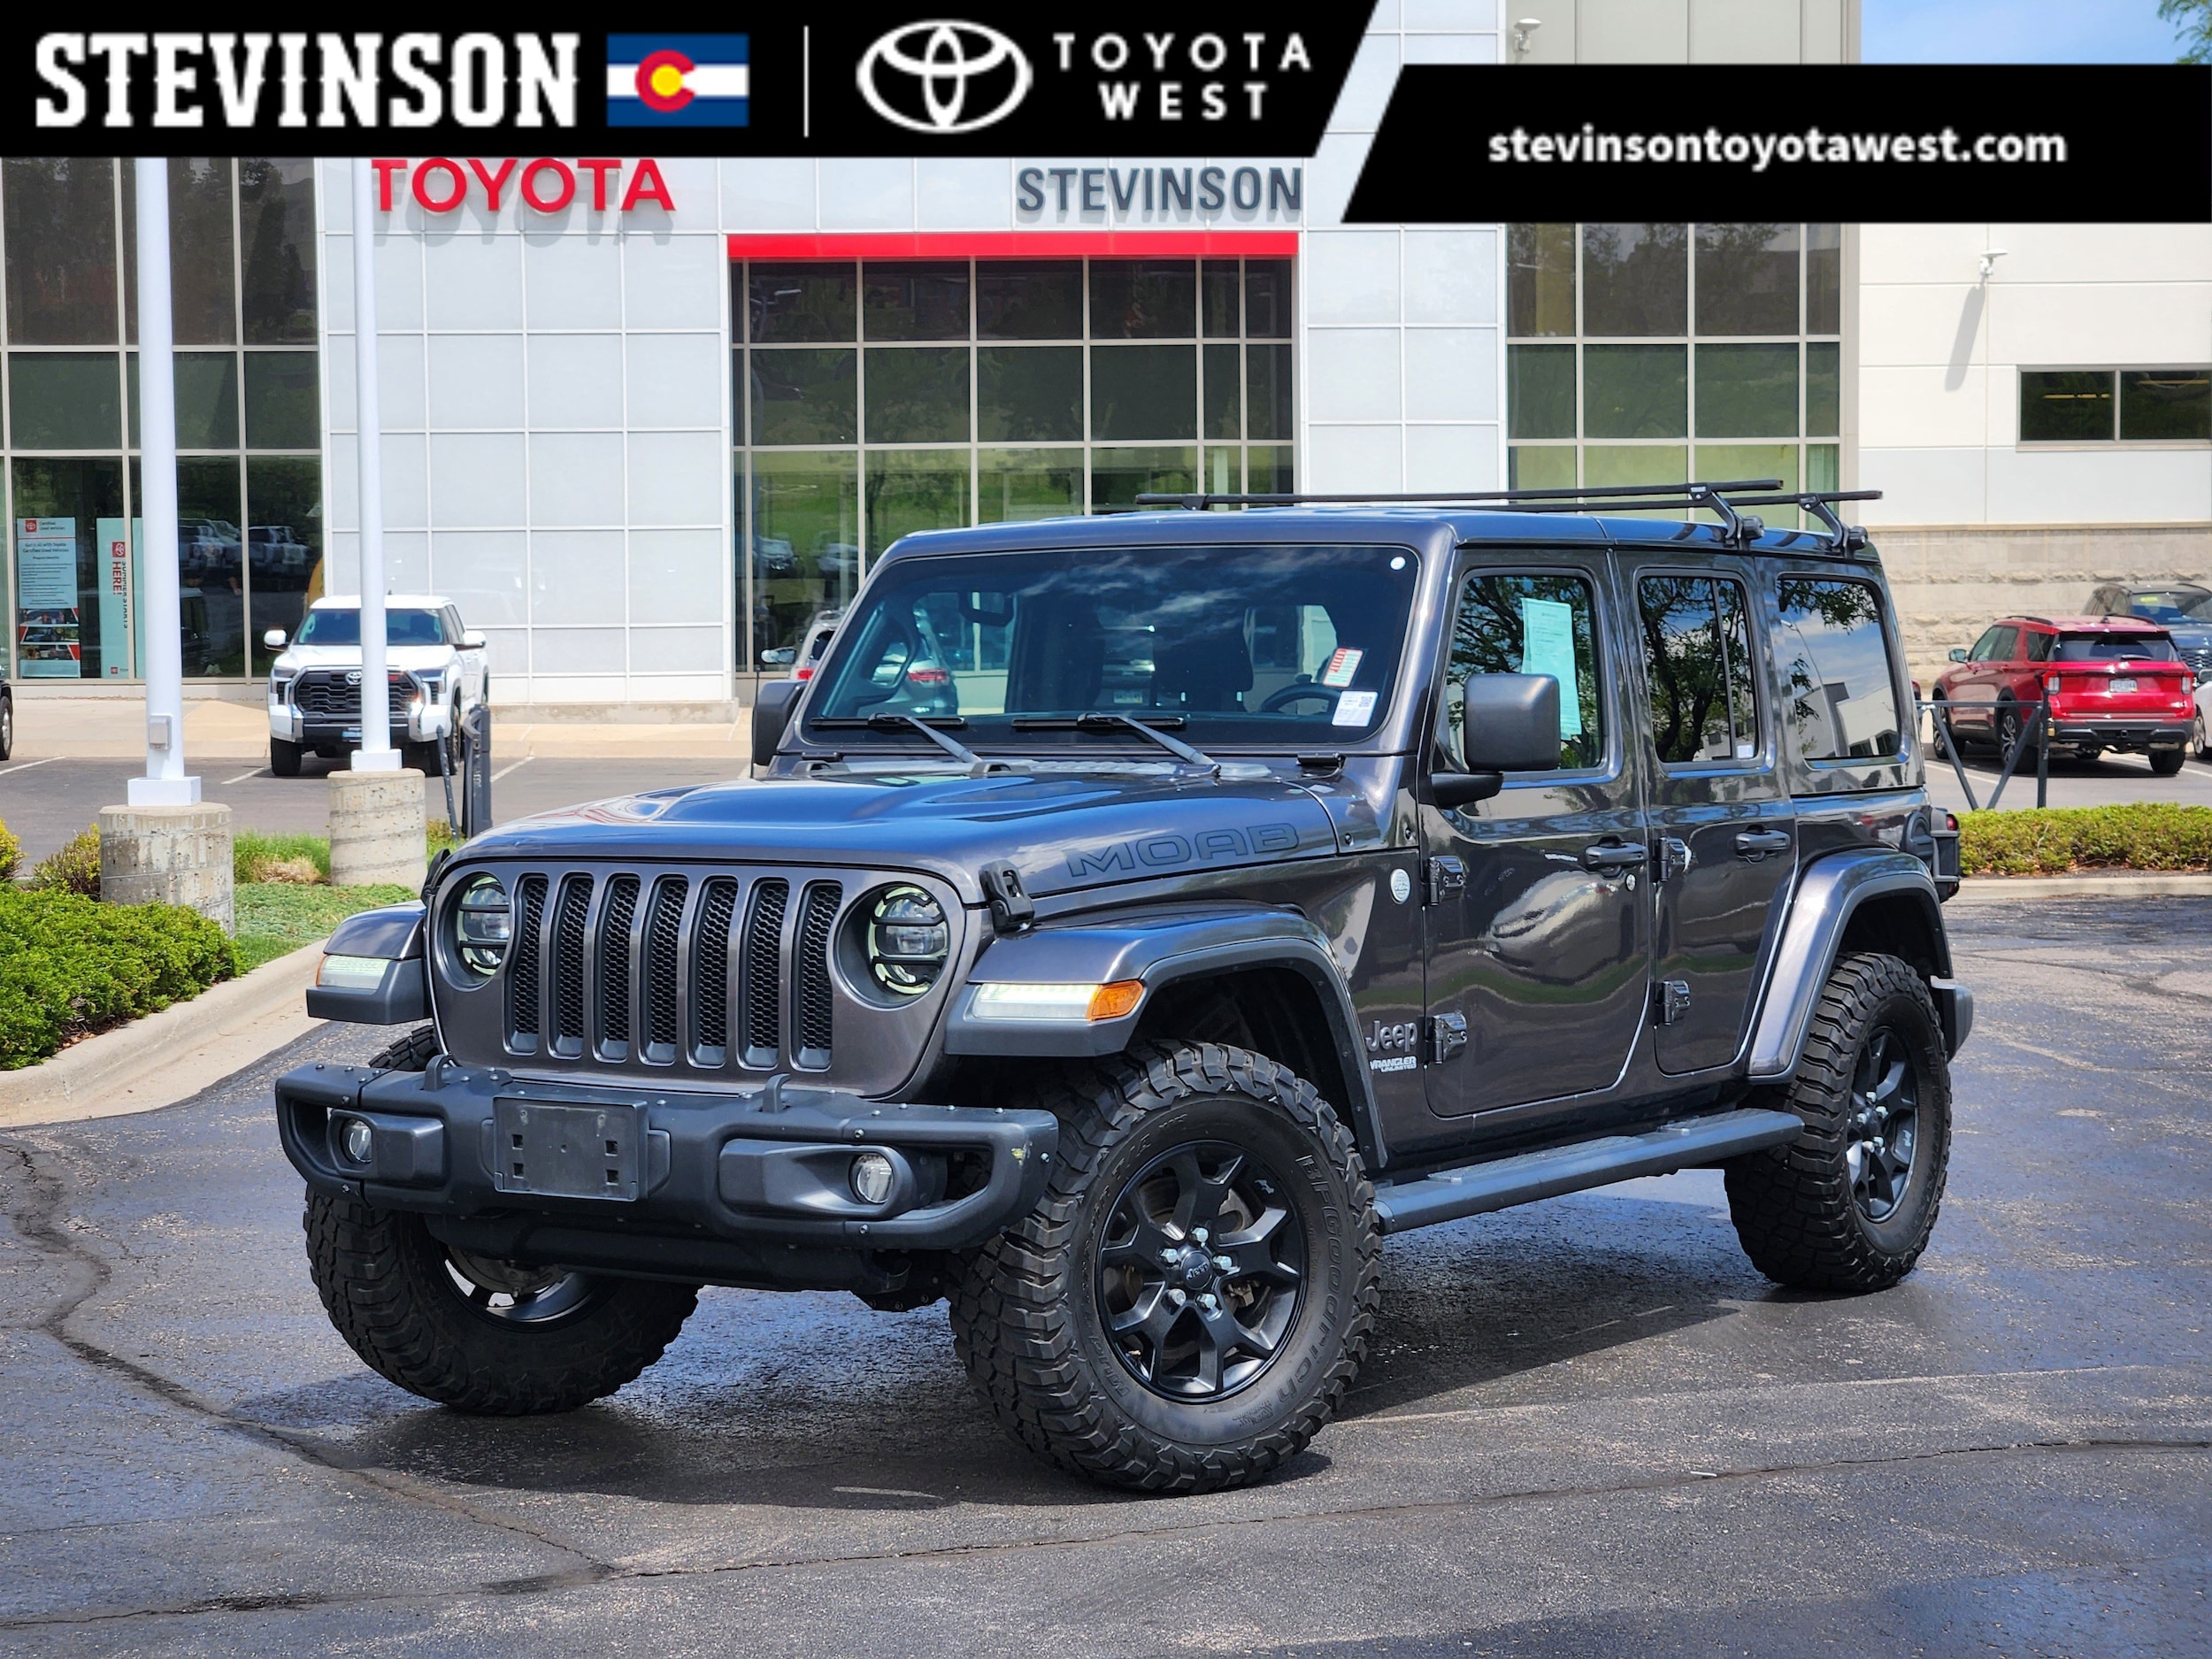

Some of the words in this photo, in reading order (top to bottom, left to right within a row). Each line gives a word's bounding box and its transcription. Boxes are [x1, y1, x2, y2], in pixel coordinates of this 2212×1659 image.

[371, 157, 676, 213] TOYOTA
[1018, 165, 1302, 212] STEVINSON
[112, 561, 122, 595] HERE!
[1066, 822, 1301, 878] MOAB
[1364, 1018, 1418, 1053] Jeep
[1369, 1056, 1417, 1071] WRANGLER
[1380, 1064, 1417, 1072] UNLIMITED
[1186, 1262, 1209, 1280] Jeep
